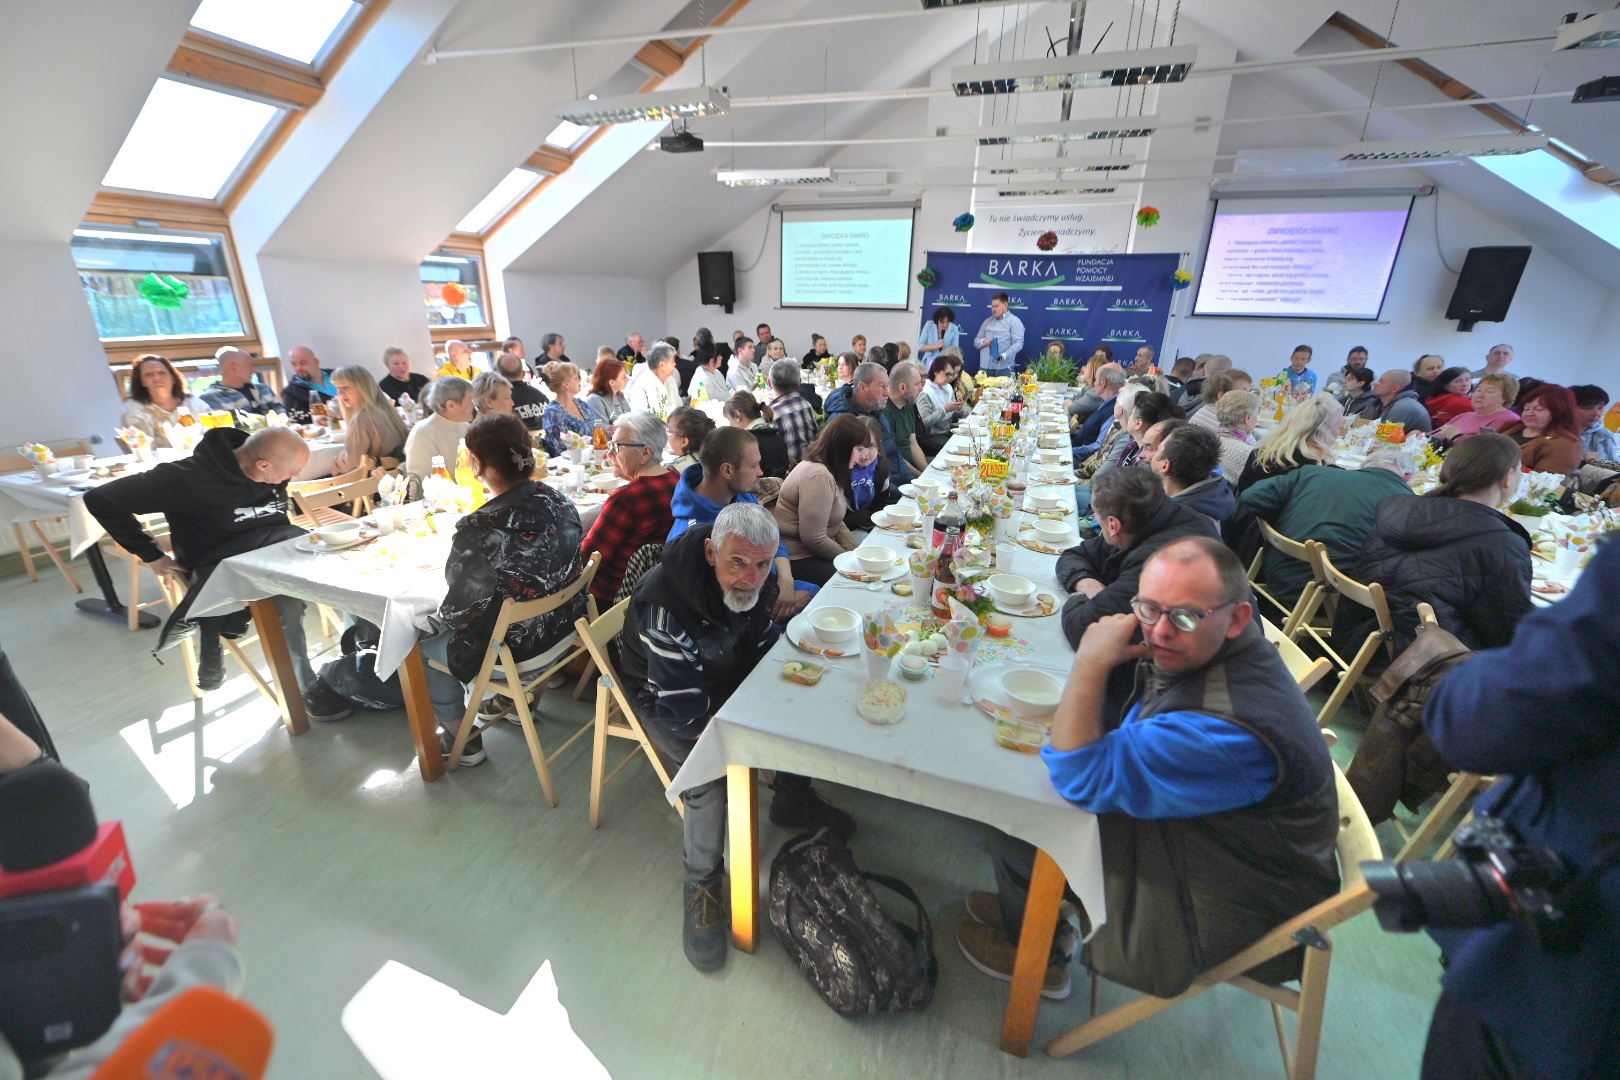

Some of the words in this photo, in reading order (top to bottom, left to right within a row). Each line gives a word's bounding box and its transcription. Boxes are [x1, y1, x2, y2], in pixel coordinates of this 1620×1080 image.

[989, 215, 997, 223] Tu
[999, 214, 1011, 222] nie
[1012, 213, 1060, 223] świadczymy
[1061, 212, 1085, 222] usług.
[1018, 227, 1046, 237] Życiem
[1077, 258, 1114, 266] FUNDACJA
[988, 259, 1058, 277] BARKA
[1007, 296, 1022, 304] RKA
[1053, 298, 1082, 306] BARKA
[1115, 298, 1146, 306] BARKA
[1110, 329, 1140, 337] BARKA
[980, 463, 991, 478] 2L
